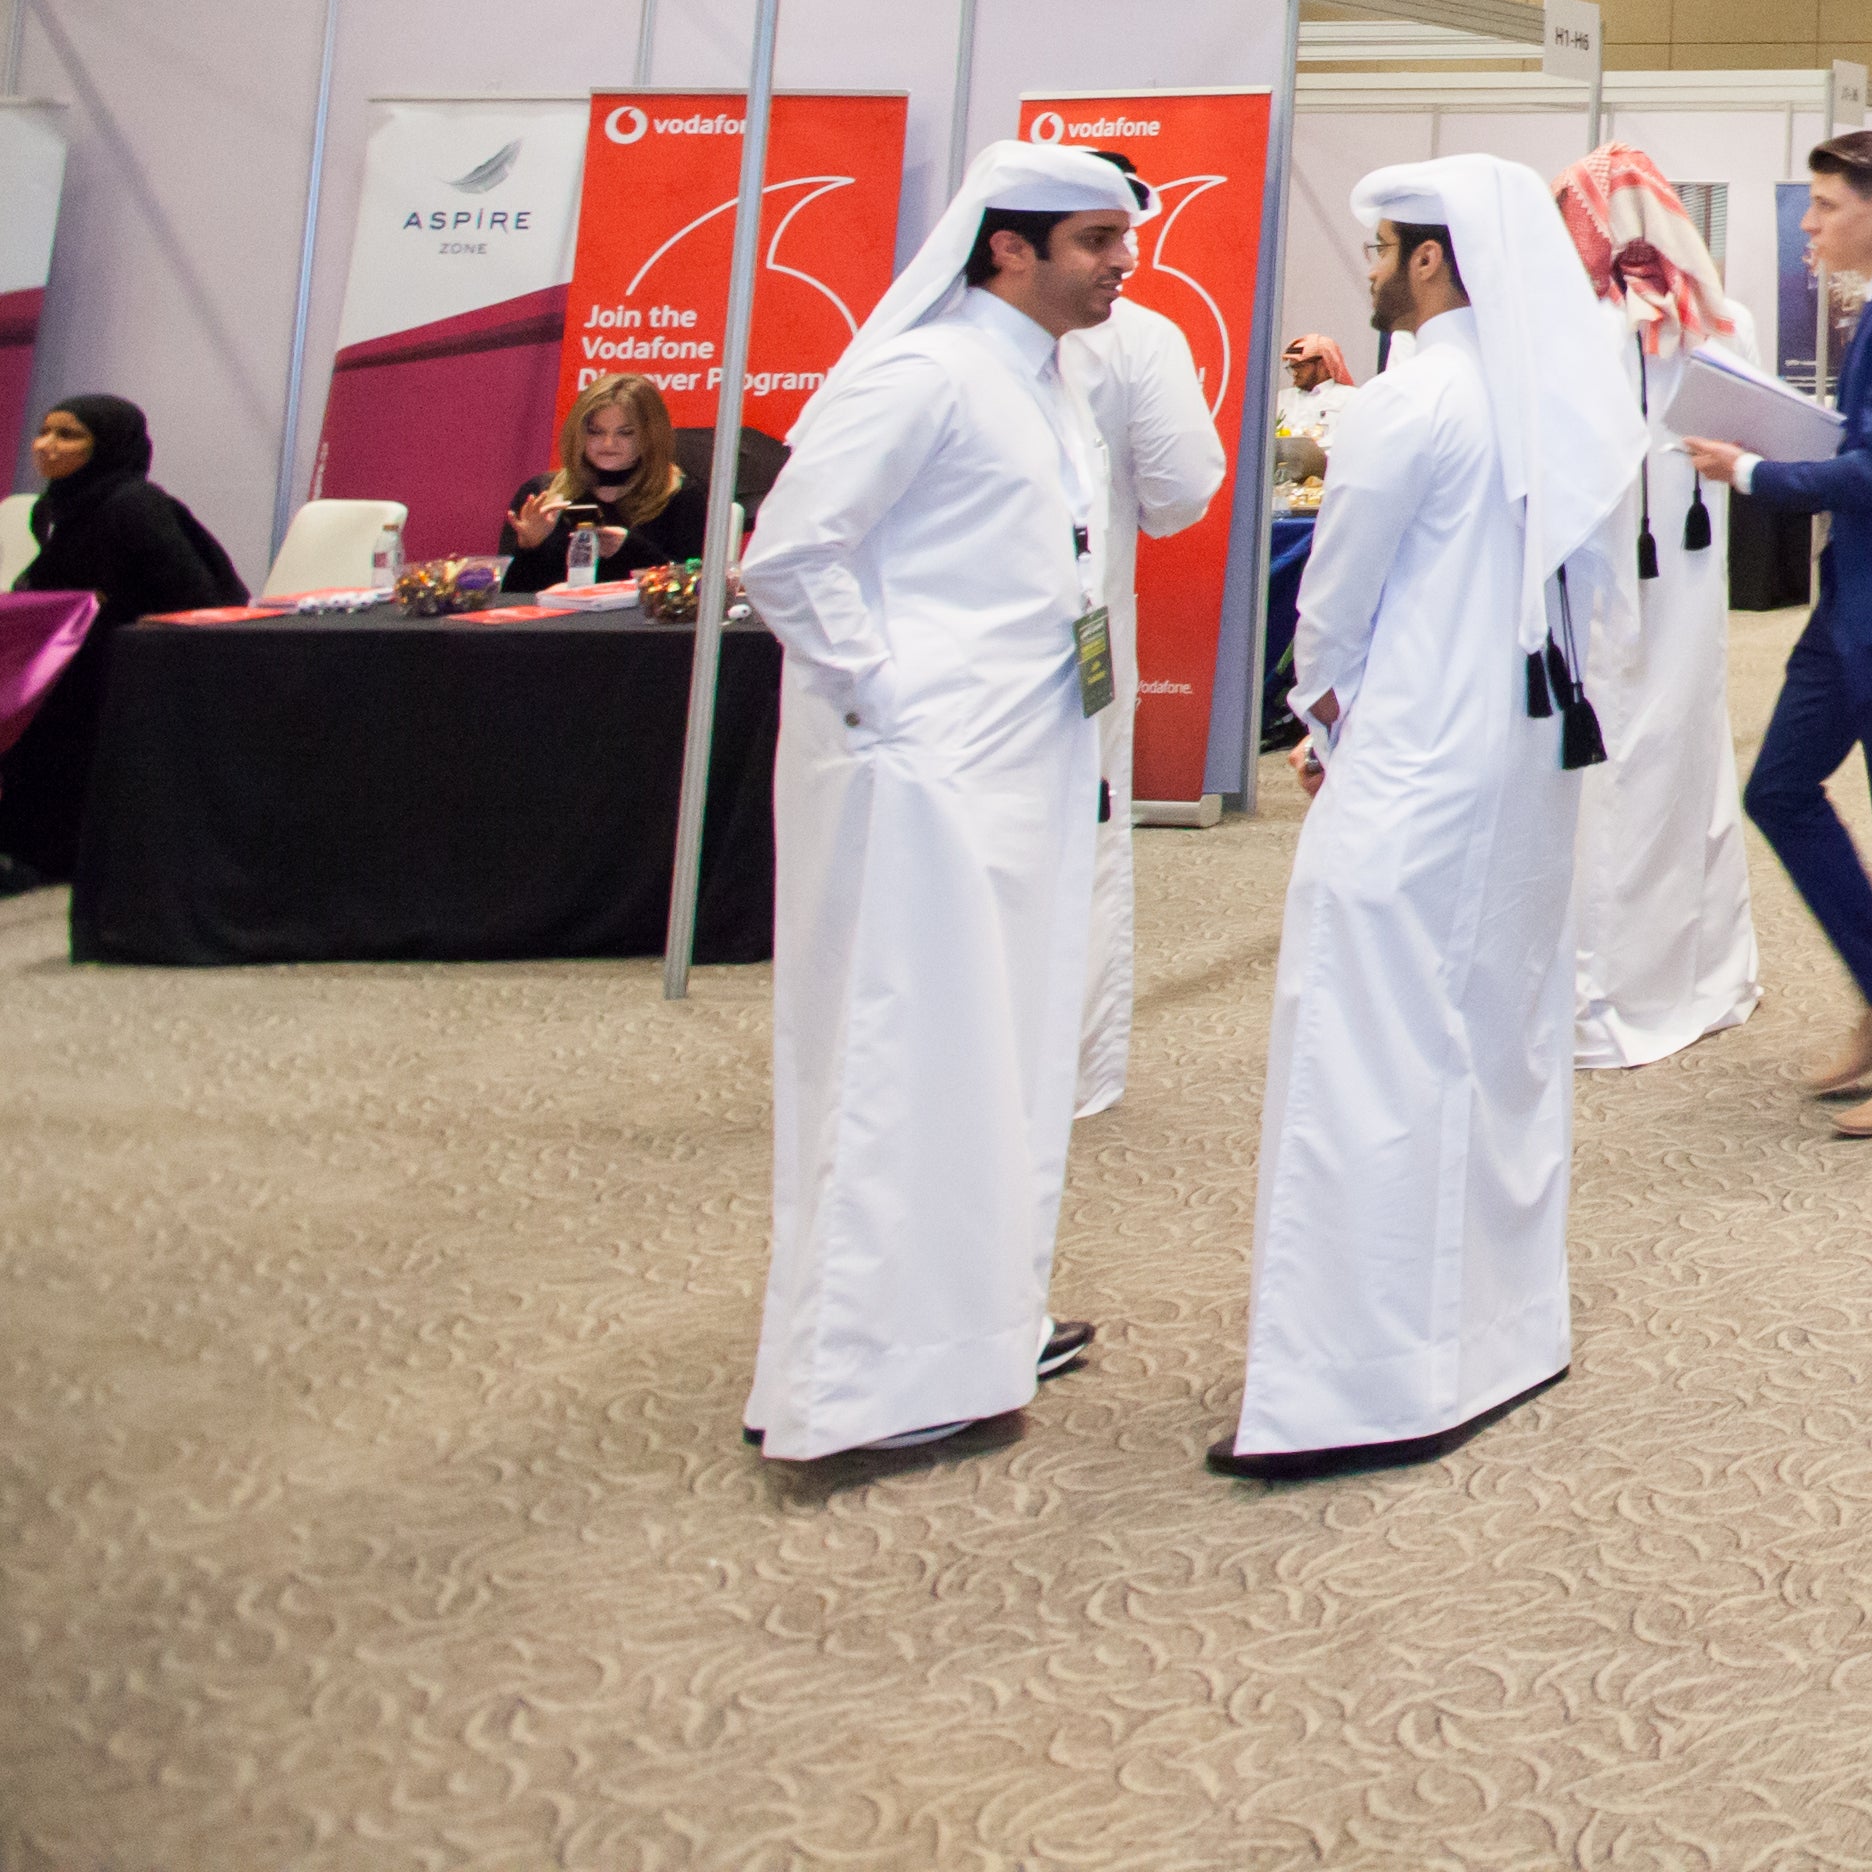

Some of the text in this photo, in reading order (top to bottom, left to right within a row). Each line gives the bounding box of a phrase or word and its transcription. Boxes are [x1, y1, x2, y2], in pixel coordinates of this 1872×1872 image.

[1555, 27, 1589, 51] H1-H6
[654, 114, 747, 135] vodafo
[1068, 116, 1161, 138] vodafone
[403, 208, 532, 233] ASPIRE
[439, 243, 488, 255] ZONE
[583, 305, 697, 329] Join the
[581, 337, 715, 360] Vodafone
